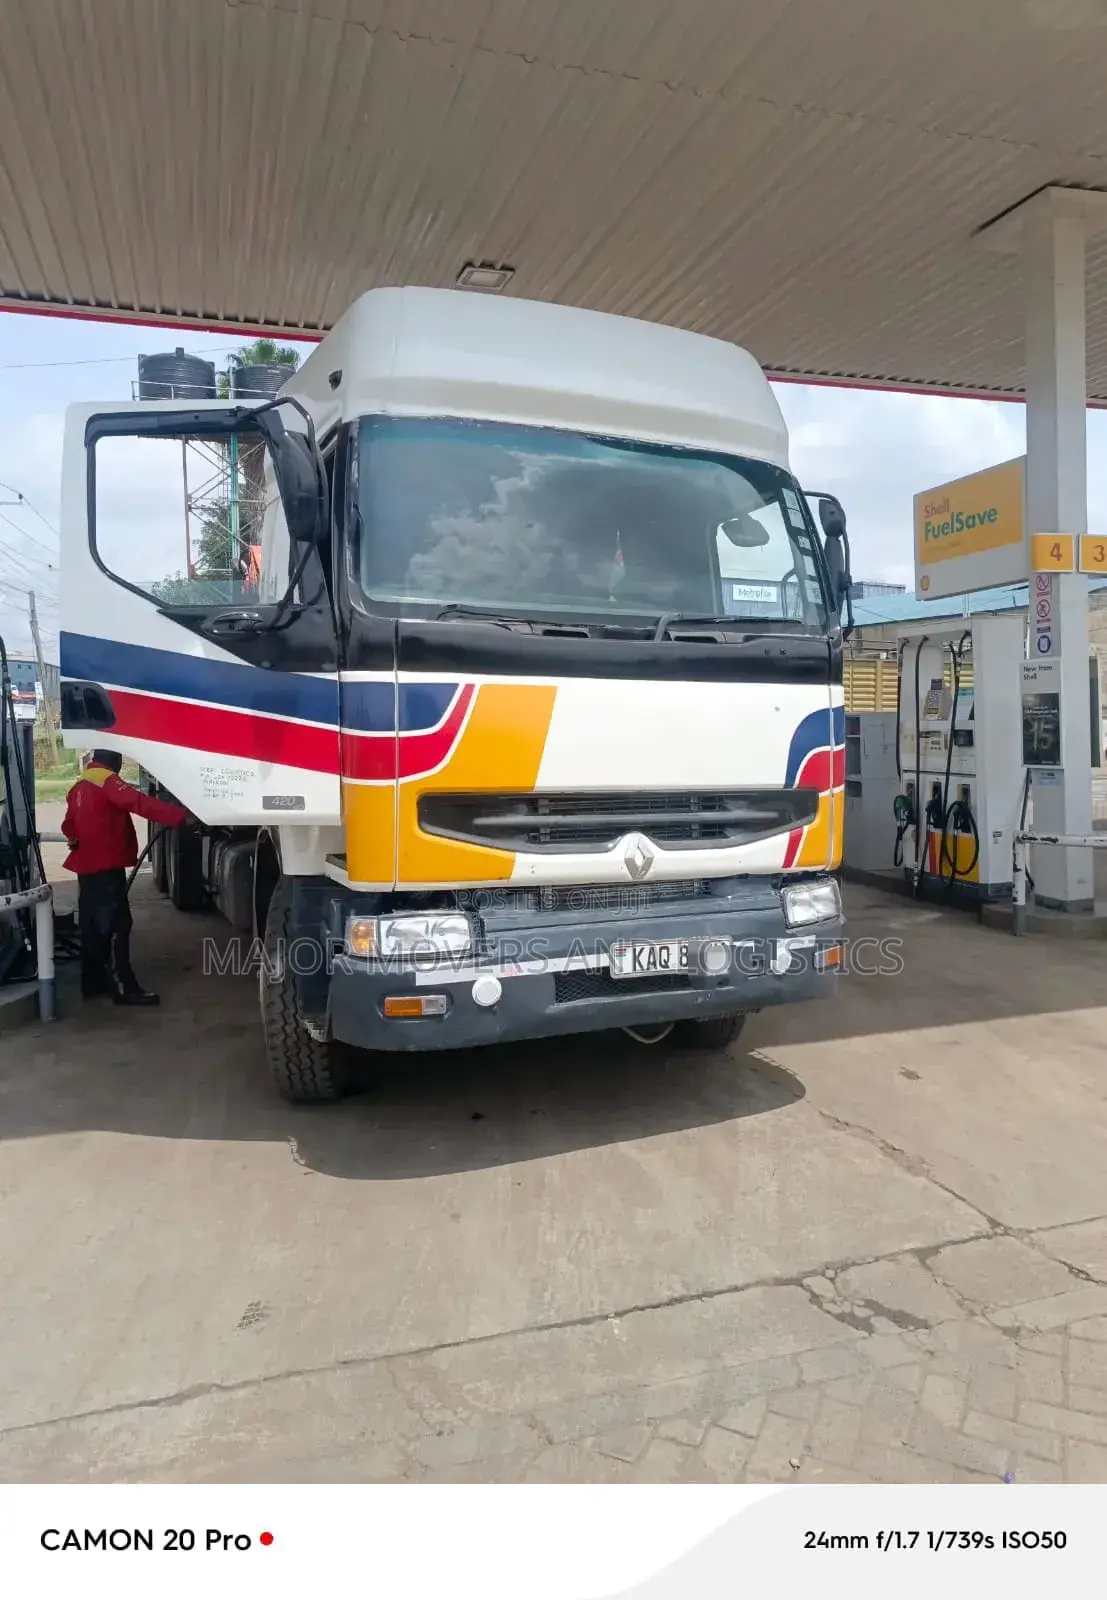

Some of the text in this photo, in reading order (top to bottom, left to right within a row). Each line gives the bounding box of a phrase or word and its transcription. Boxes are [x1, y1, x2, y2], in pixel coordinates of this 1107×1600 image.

[924, 498, 950, 519] Shell
[925, 508, 998, 542] FuelSave
[1049, 542, 1063, 562] 4
[1092, 544, 1106, 563] 3
[272, 796, 296, 806] 420
[633, 945, 670, 971] KAQ
